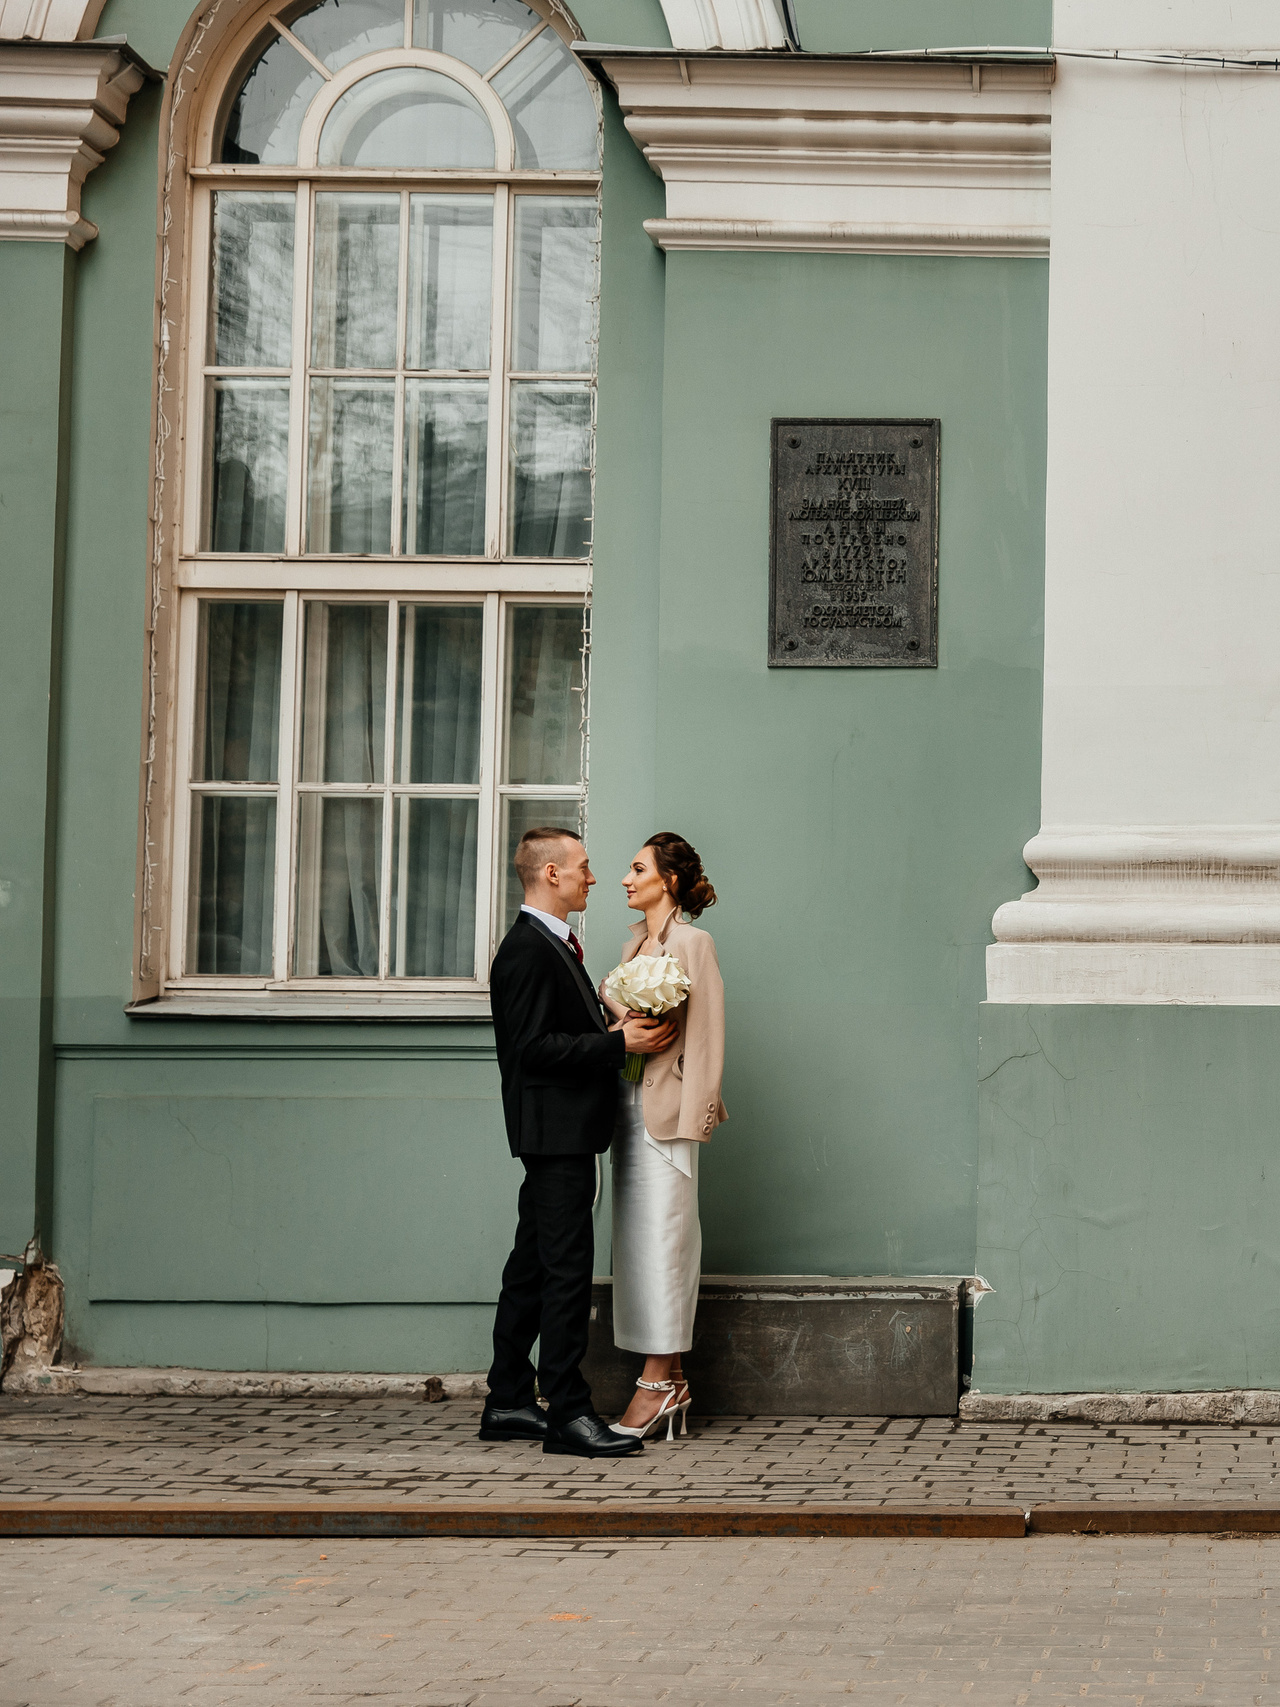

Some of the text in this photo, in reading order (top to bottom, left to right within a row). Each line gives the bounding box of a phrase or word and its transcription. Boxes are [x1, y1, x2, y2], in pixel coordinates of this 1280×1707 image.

[816, 452, 896, 464] ПАМЯТНИК
[805, 464, 906, 476] АРХИТЕКТУРЫ
[802, 499, 907, 511] ЗДАНИЕ БЫВШЕЙ
[789, 511, 920, 521] ЛЮТЕРАНСКОЙ ЦЕРКВИ
[801, 534, 907, 546] ПОСТРОЕНО
[836, 545, 871, 560] 1779
[801, 559, 907, 570] АРХИТЕКТОР
[840, 590, 868, 603] 1939
[811, 605, 894, 617] ОХРАНЯЕТСЯ
[803, 617, 903, 629] ГОСУДАРСТВОМ
